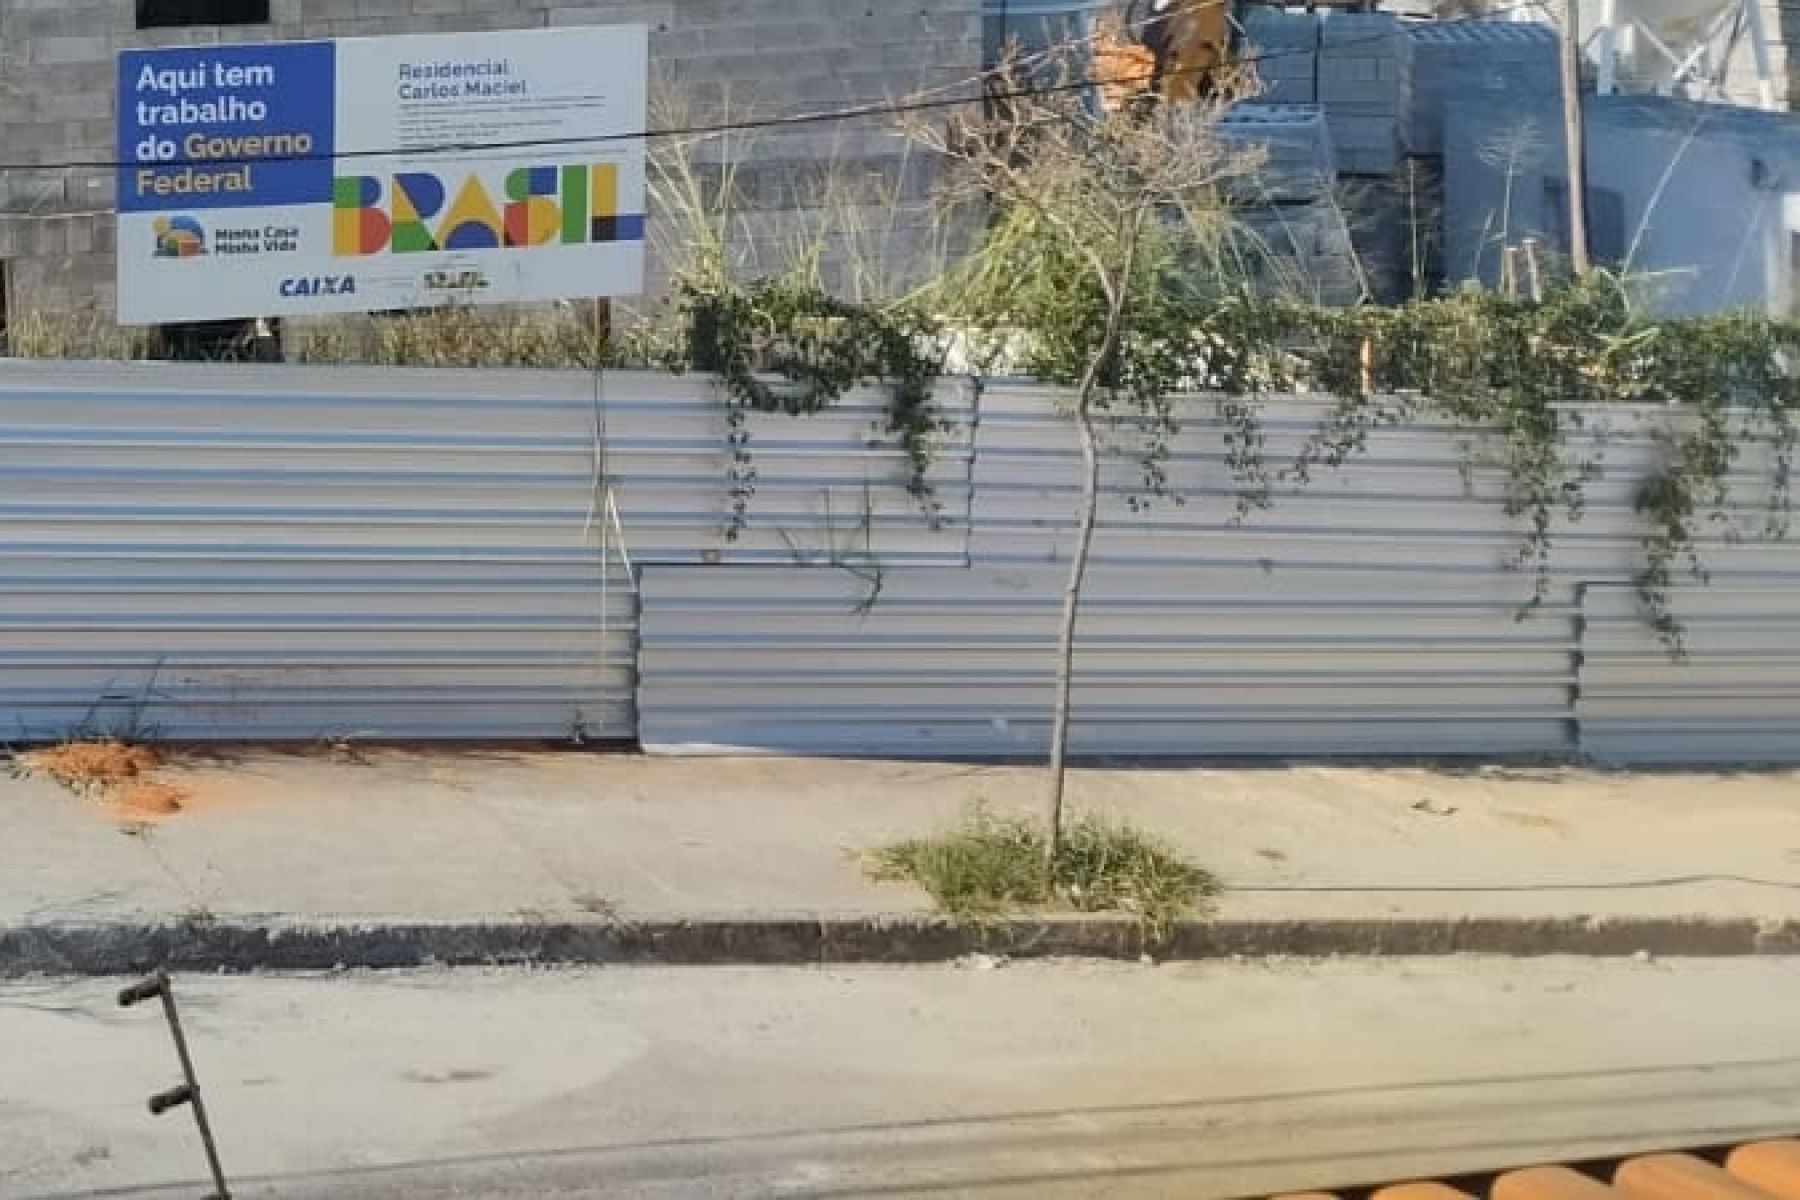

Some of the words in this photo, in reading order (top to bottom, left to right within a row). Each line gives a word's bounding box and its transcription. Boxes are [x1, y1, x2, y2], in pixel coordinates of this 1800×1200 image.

[136, 61, 206, 96] Aqui
[214, 62, 275, 88] tem
[398, 59, 509, 81] Residencial
[398, 81, 461, 100] Carlos
[465, 79, 527, 97] Maciel
[136, 96, 267, 126] trabalho
[136, 135, 177, 161] do
[183, 132, 313, 158] Governo
[136, 165, 254, 197] Federal
[332, 163, 645, 256] BRASIL
[279, 275, 356, 298] CAIXA
